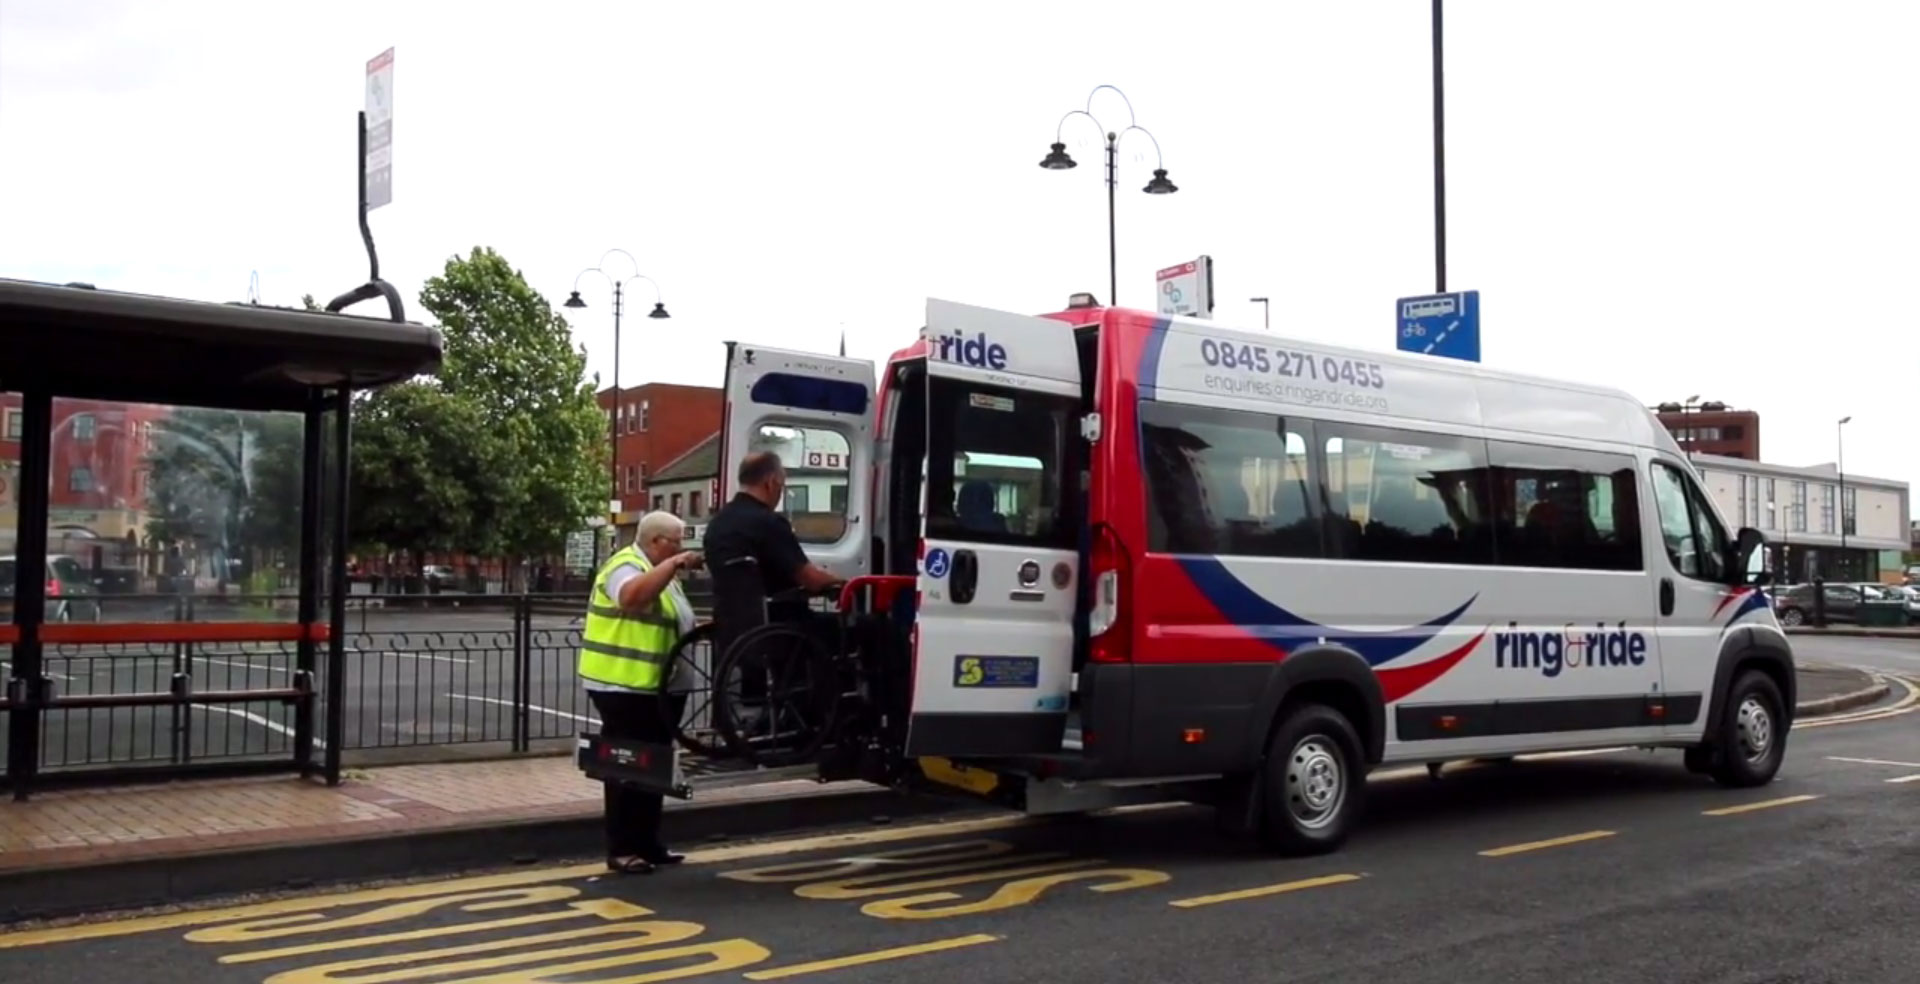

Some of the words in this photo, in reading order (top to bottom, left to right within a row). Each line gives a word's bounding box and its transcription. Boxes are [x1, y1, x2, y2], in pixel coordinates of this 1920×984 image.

[1201, 338, 1271, 373] 0845
[1276, 350, 1319, 379] 271
[1323, 358, 1385, 389] 0455
[1204, 373, 1388, 411] enquiries@ringandride.org
